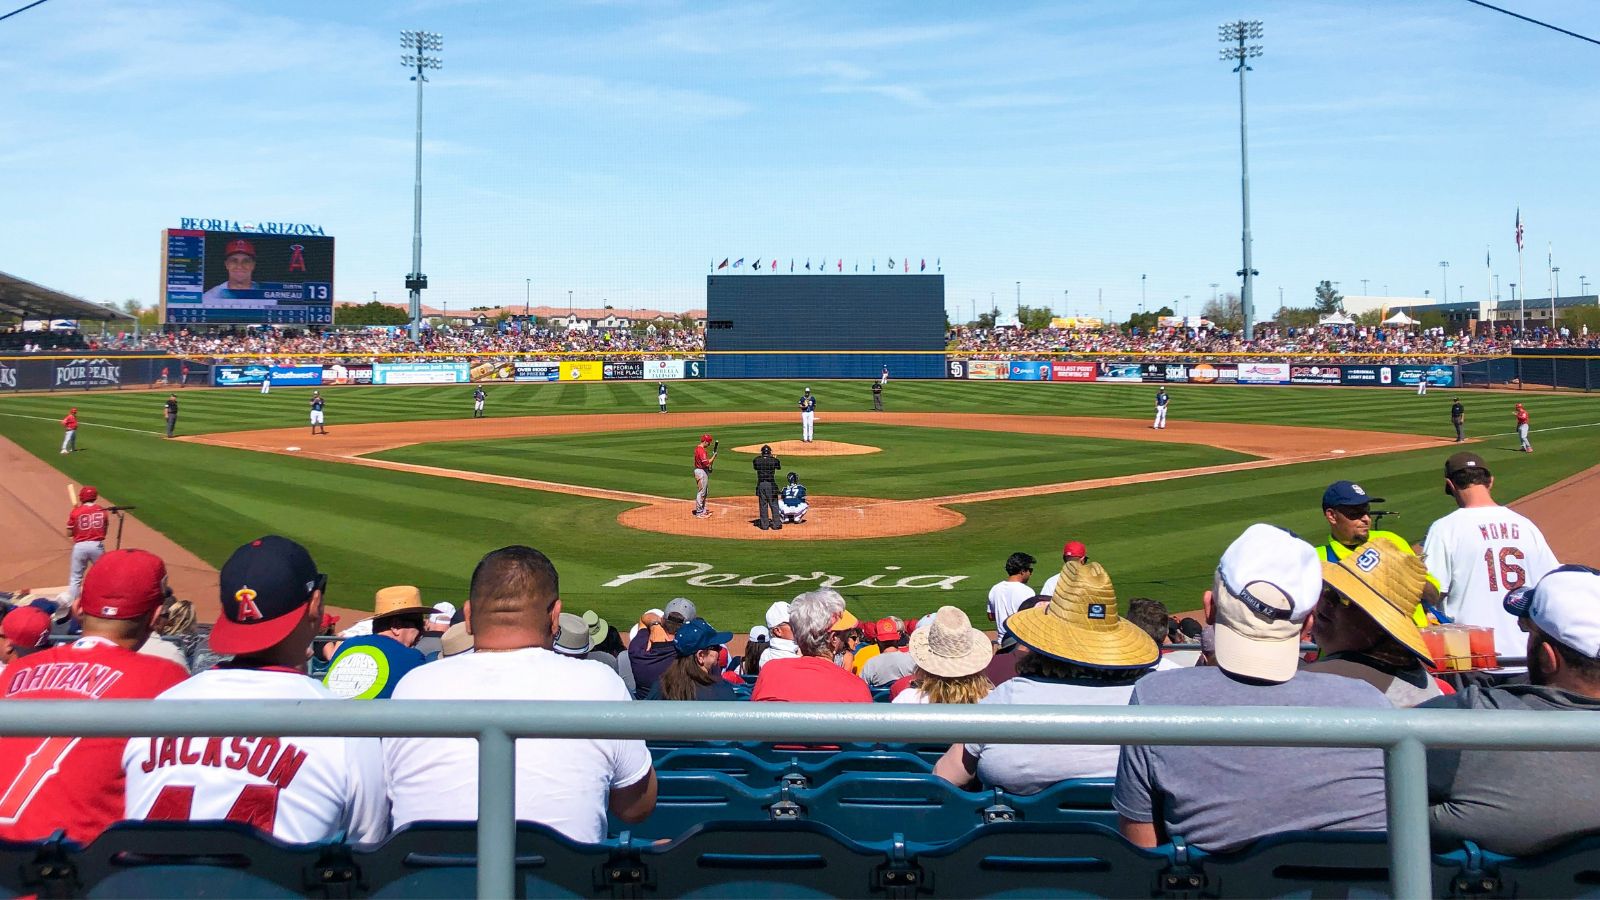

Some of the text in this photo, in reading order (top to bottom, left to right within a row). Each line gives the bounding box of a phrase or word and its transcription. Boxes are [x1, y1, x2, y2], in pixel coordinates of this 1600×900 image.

[181, 217, 325, 236] PEORIA ARIZONA
[308, 286, 328, 300] 13
[56, 367, 86, 385] FOUR
[786, 488, 800, 499] 27
[78, 512, 104, 530] 85
[1478, 523, 1520, 541] WONG
[601, 561, 970, 589] Peoria
[1484, 547, 1526, 592] 16
[1260, 608, 1273, 616] AZ
[4, 662, 124, 699] OHTANI
[141, 737, 308, 789] JACKSON
